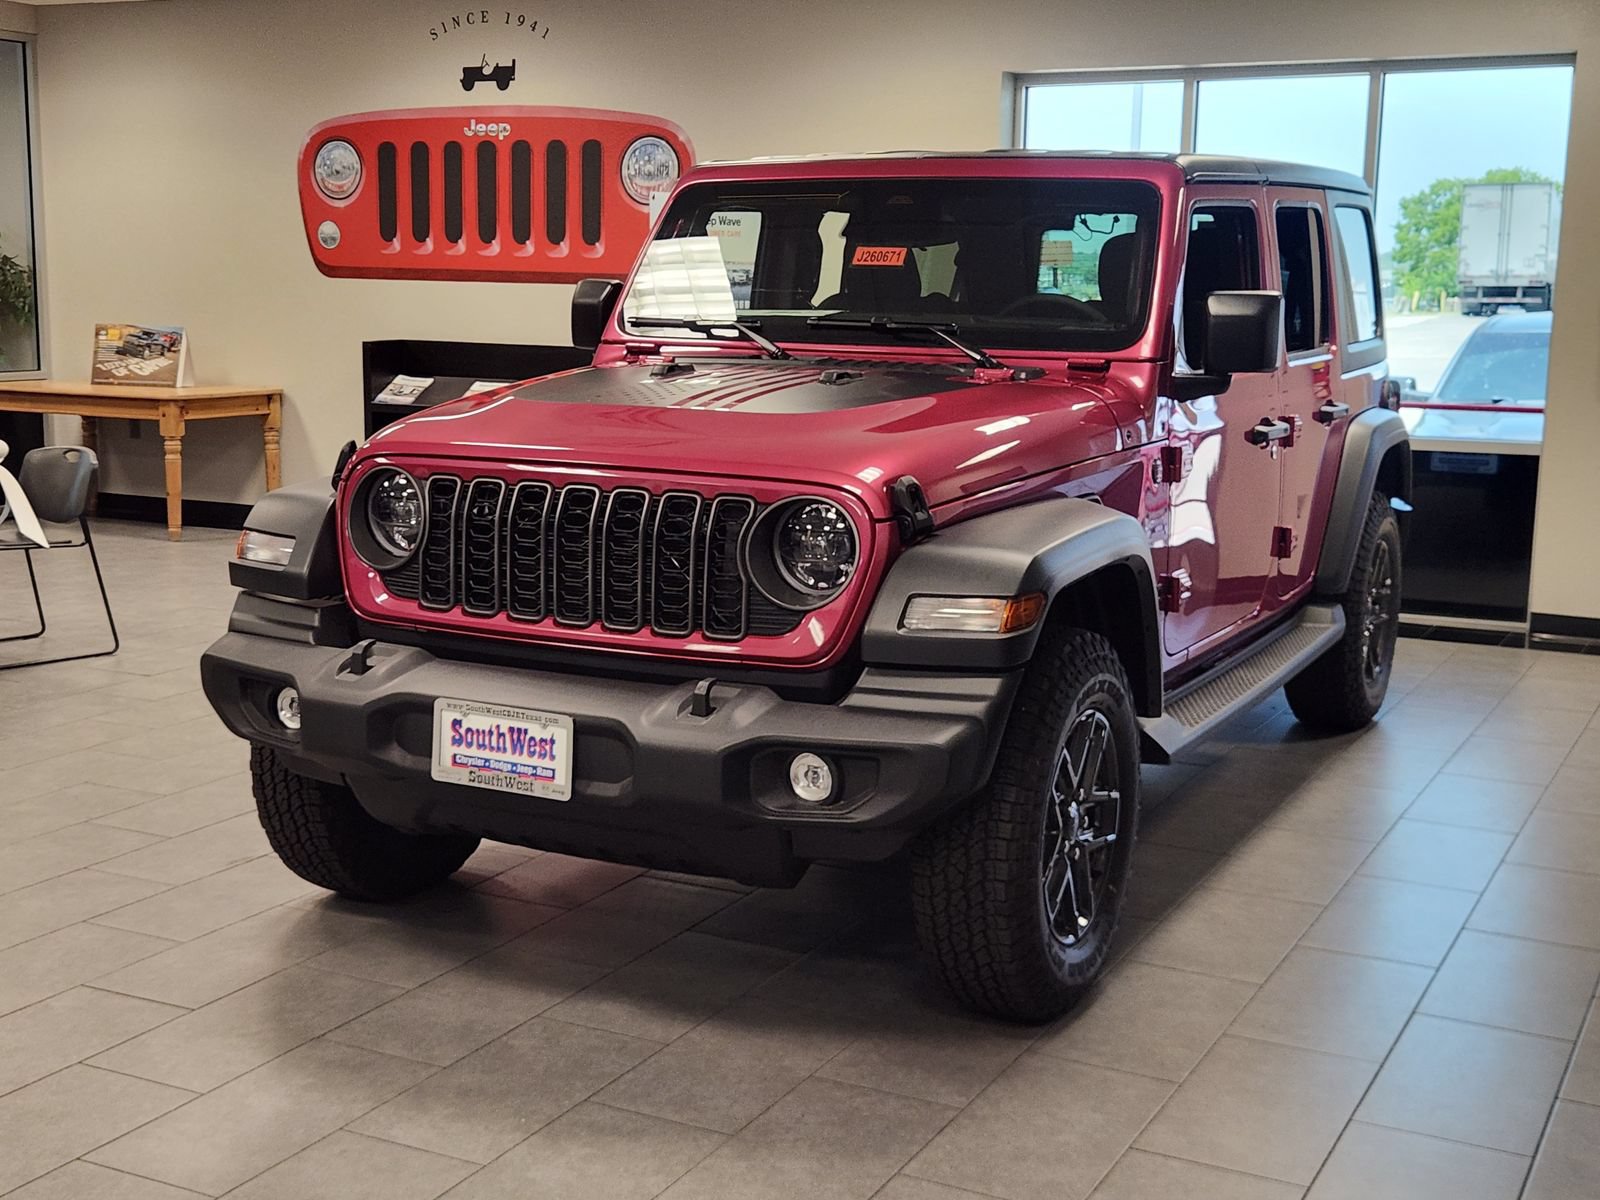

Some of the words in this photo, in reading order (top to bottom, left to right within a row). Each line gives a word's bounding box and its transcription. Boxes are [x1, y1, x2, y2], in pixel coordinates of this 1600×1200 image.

[429, 10, 489, 41] SINCE
[505, 11, 550, 40] 1941
[463, 119, 511, 140] Jeep
[718, 215, 742, 227] Wave
[856, 250, 903, 263] J260671
[451, 718, 556, 761] SouthWest
[455, 754, 485, 768] Chrysler
[489, 760, 513, 773] Dodge
[516, 764, 534, 776] Jeep
[536, 766, 554, 778] Ram
[468, 770, 535, 793] SouthWest
